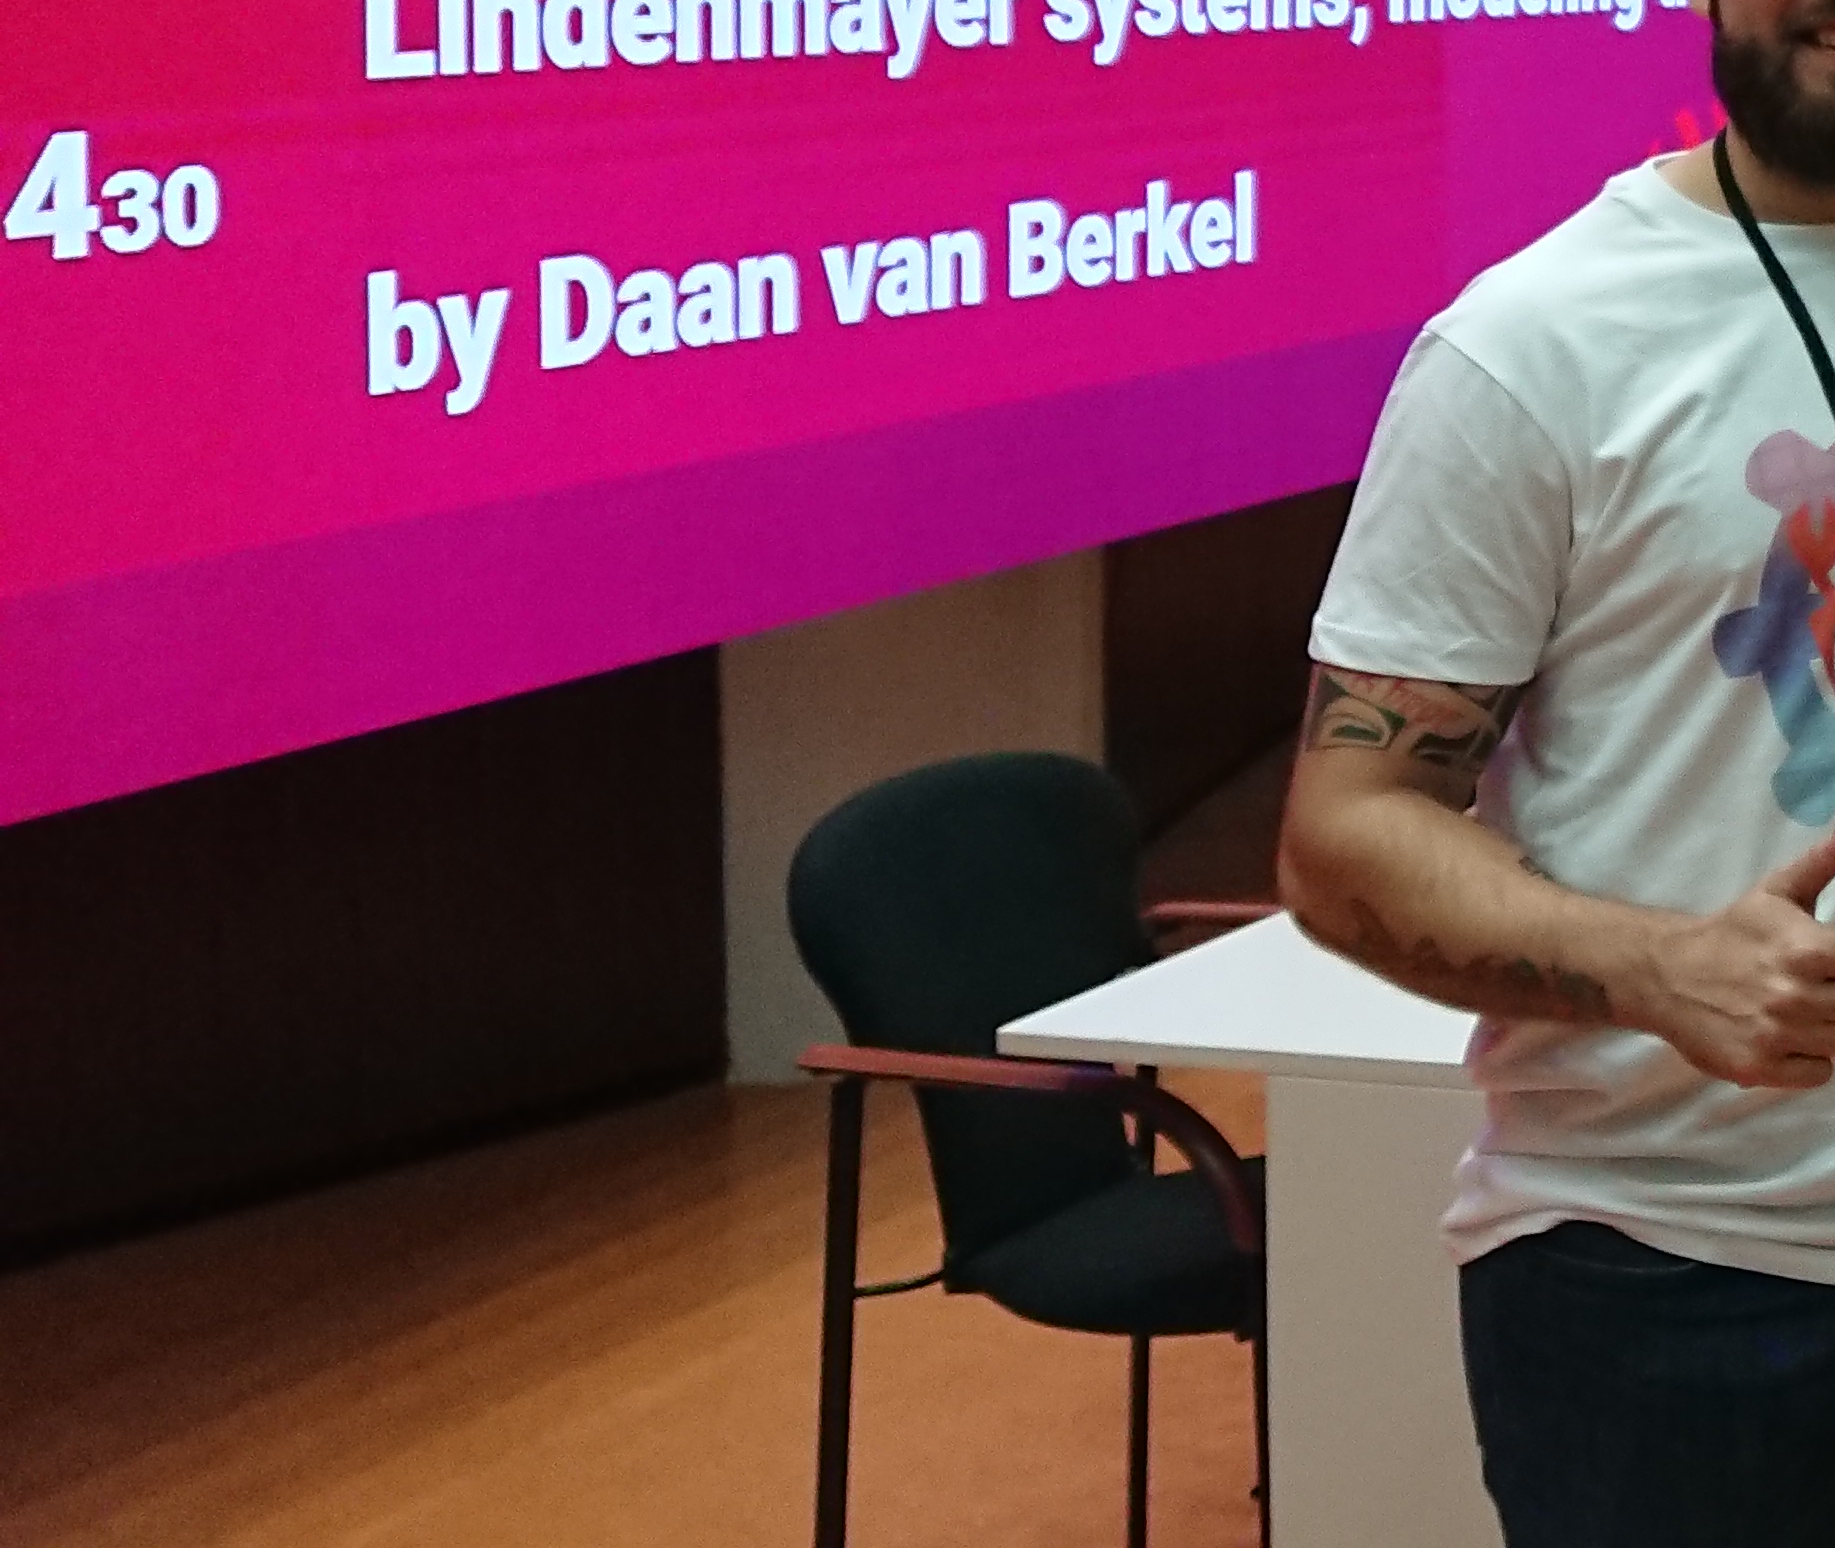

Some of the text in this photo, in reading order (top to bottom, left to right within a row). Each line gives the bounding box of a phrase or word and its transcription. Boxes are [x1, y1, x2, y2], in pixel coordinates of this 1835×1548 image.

[368, 171, 1255, 414] by Daan van Berkel
